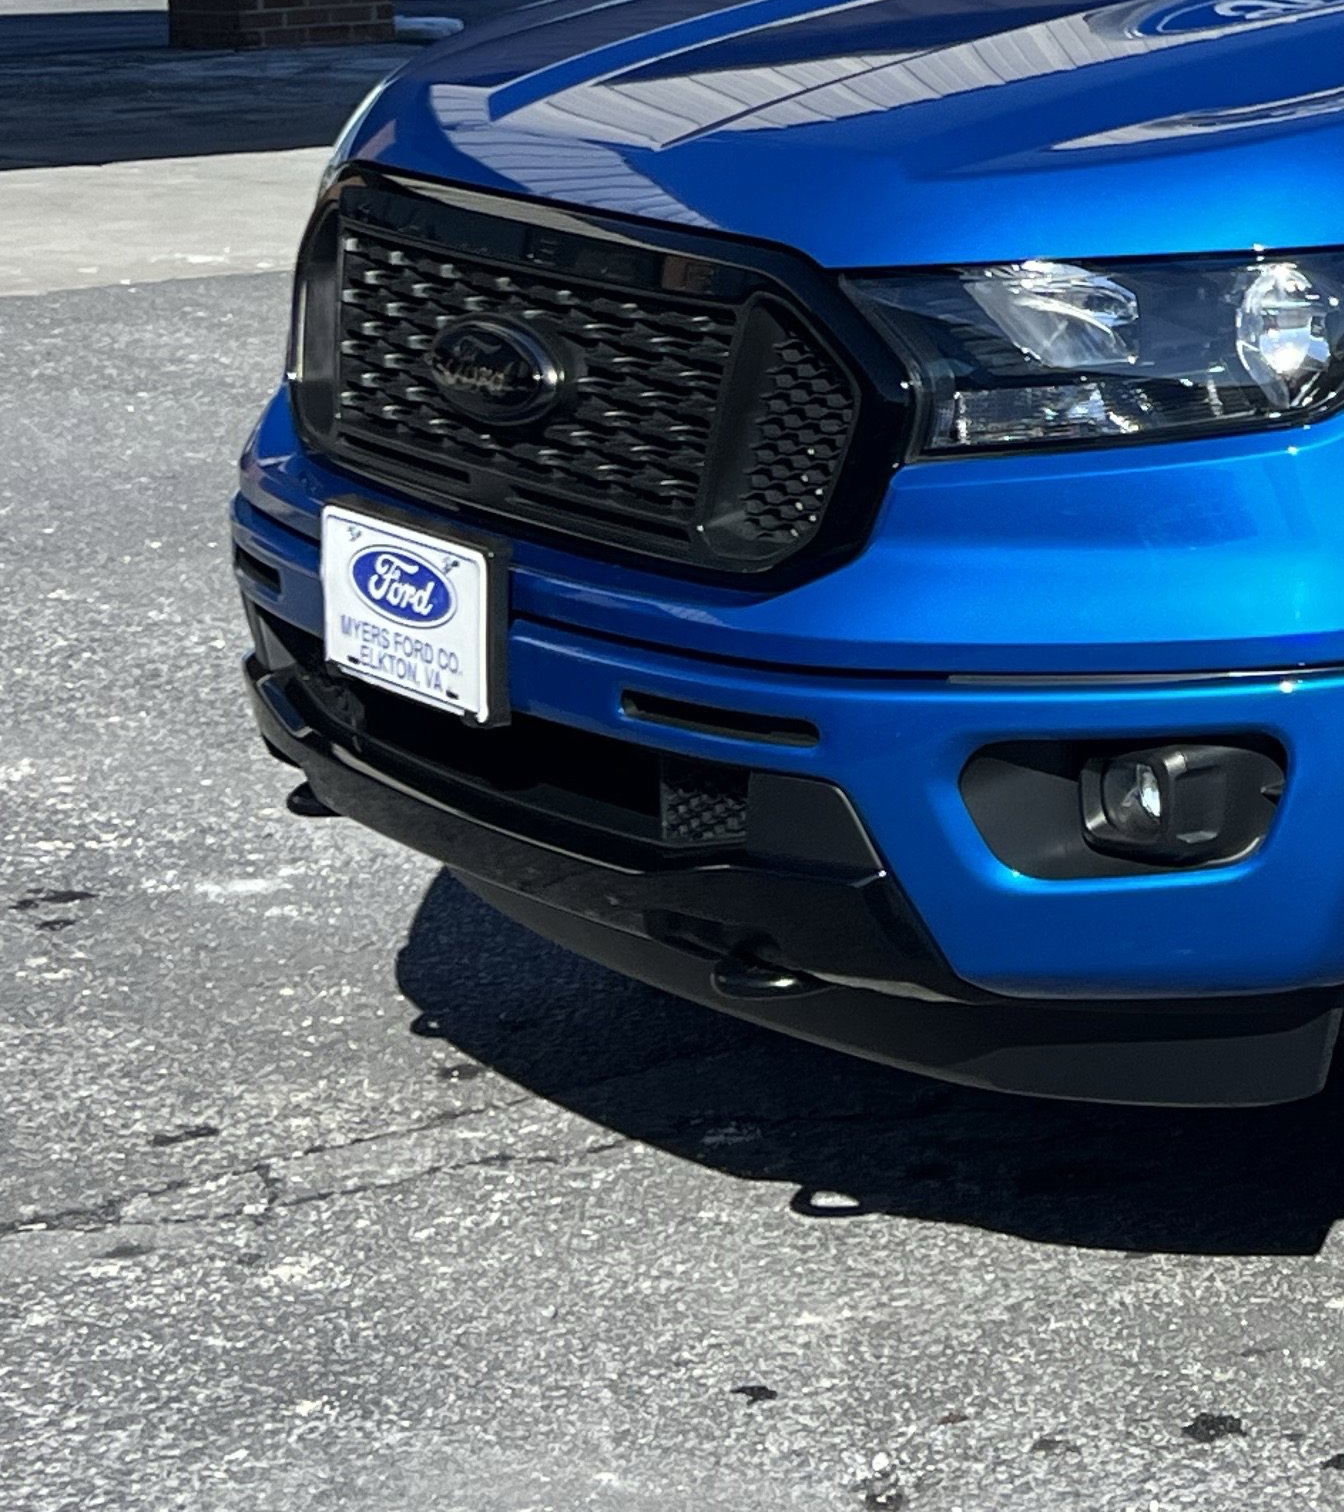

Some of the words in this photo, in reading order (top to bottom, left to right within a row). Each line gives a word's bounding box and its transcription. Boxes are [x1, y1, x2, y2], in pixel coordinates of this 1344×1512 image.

[370, 553, 435, 616] Ford
[340, 614, 390, 650] MYERS
[394, 632, 433, 664] FORD
[437, 648, 463, 677] CO.
[360, 644, 421, 689] ELKTON,
[425, 669, 444, 692] VA
